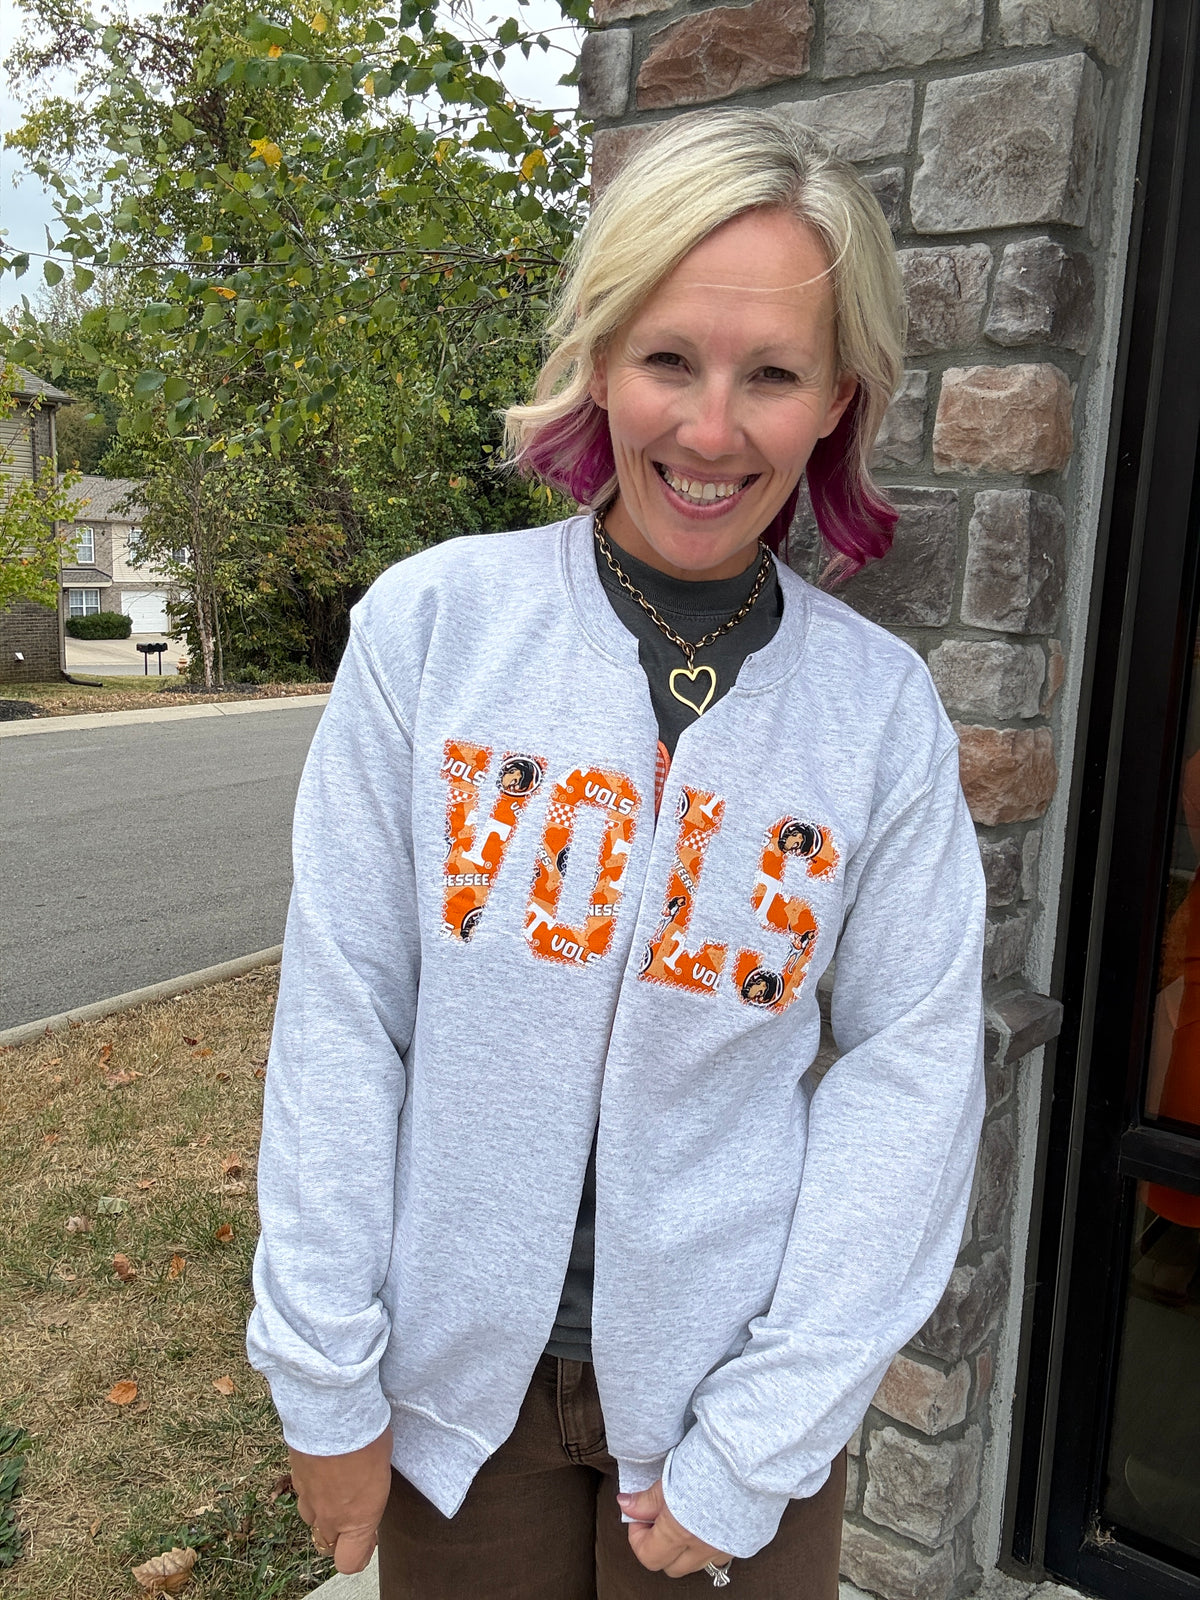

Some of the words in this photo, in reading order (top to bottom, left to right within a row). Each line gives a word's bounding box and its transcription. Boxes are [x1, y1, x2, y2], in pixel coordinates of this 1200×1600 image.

[584, 780, 635, 815] VOLS
[440, 738, 841, 1015] VOLS
[445, 873, 490, 887] ESSEE
[674, 857, 696, 895] TEERS
